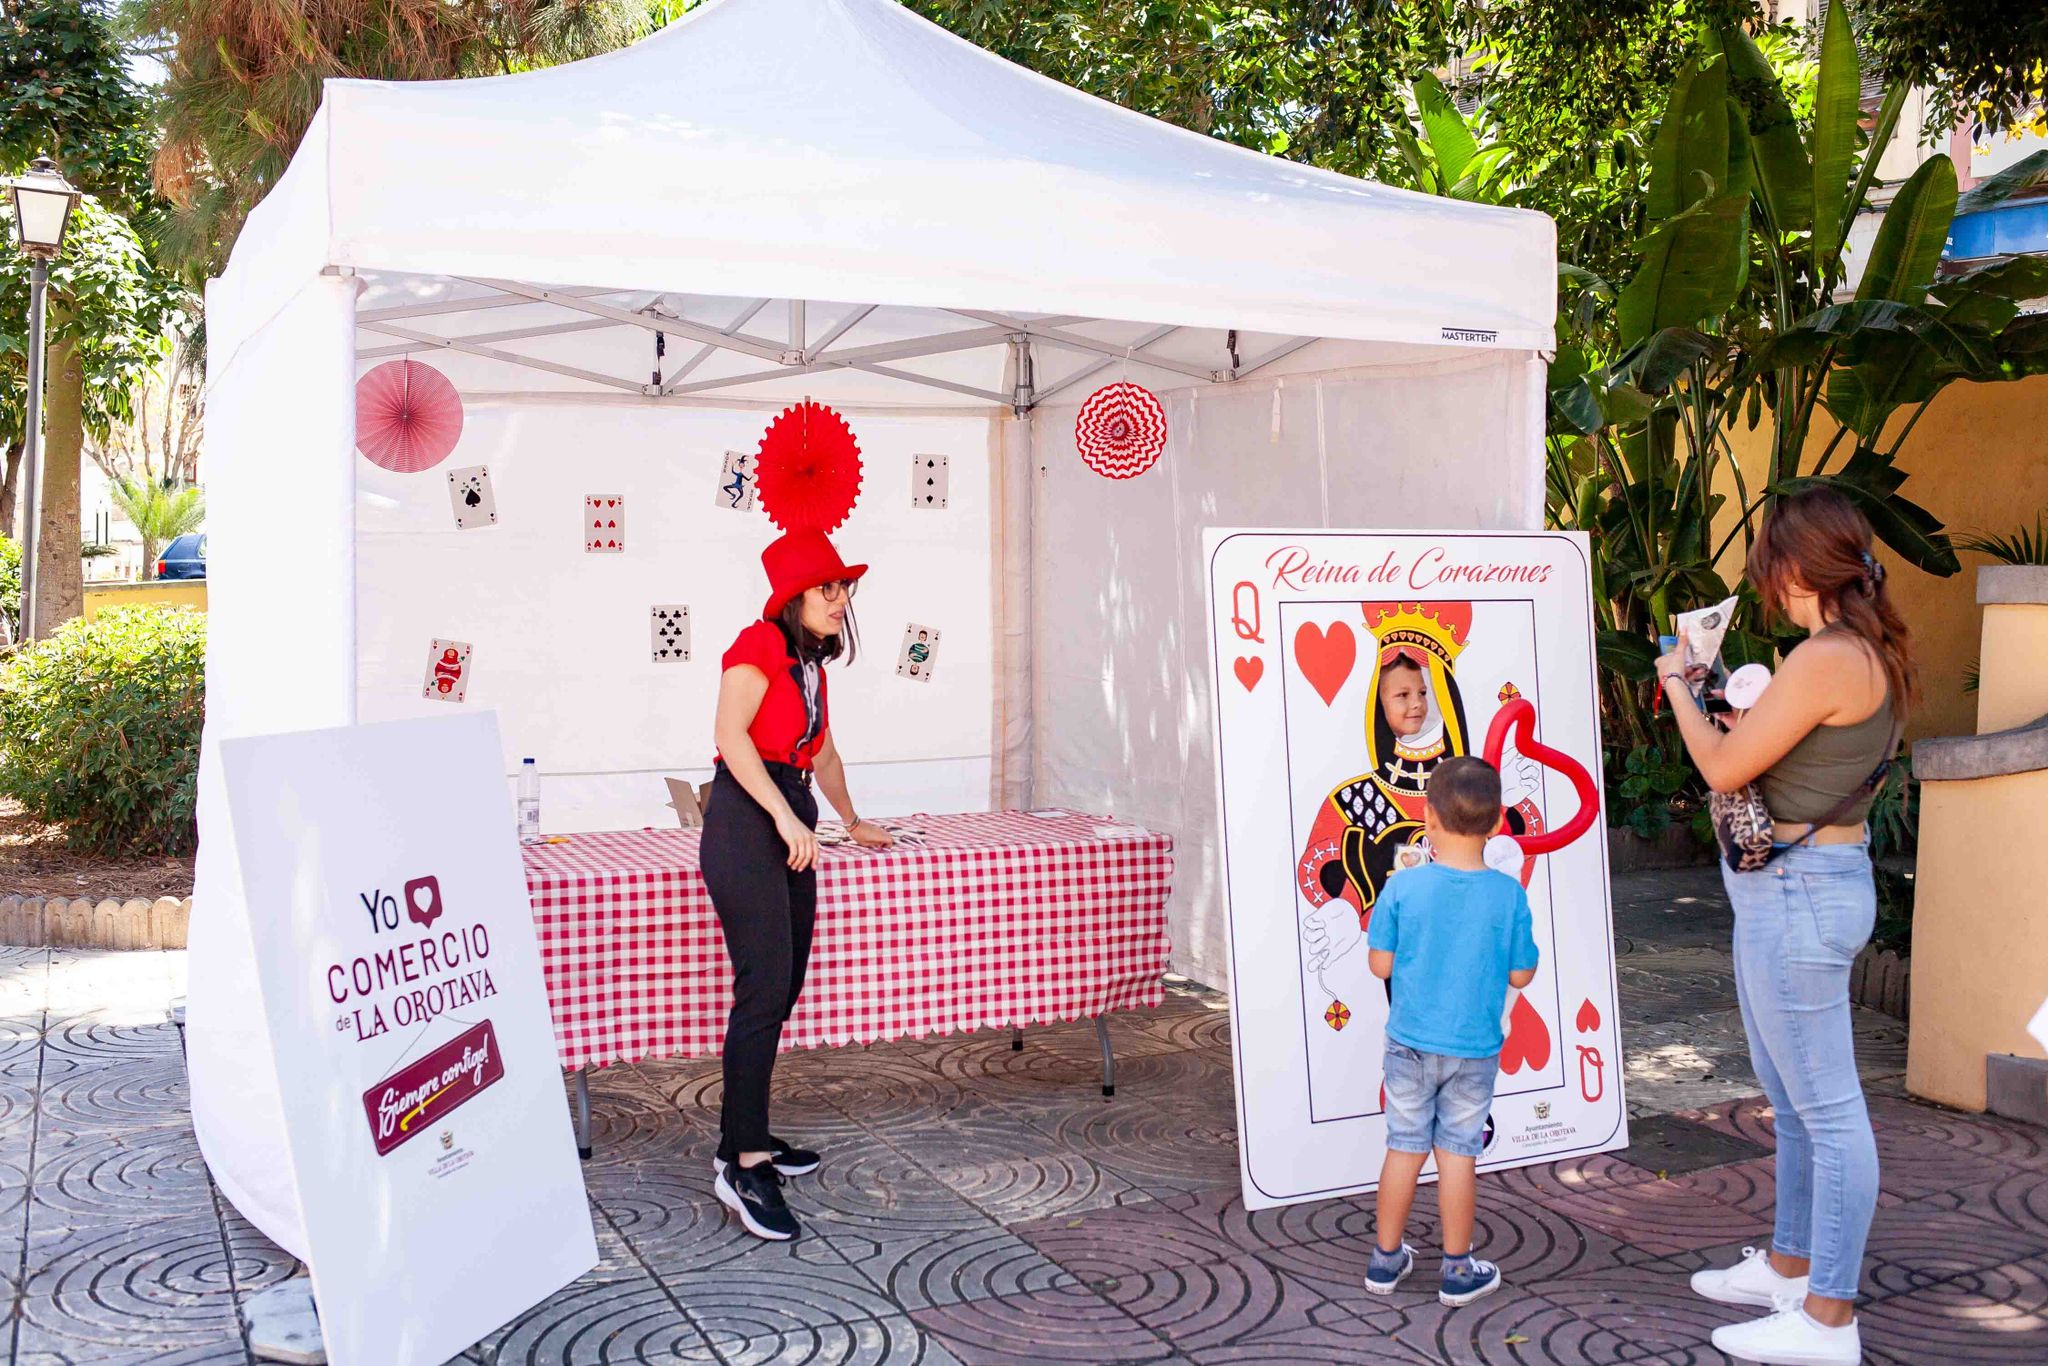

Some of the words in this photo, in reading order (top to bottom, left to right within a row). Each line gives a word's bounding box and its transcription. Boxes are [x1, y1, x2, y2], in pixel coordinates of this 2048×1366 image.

[1441, 331, 1498, 343] MASTERTENT
[1265, 545, 1361, 592] Reina
[1367, 550, 1401, 583] de
[1408, 546, 1553, 590] Corazones
[1231, 581, 1264, 644] Q
[327, 923, 490, 1004] COMERCIO
[335, 1014, 352, 1031] de
[352, 1003, 390, 1042] LA
[394, 968, 498, 1026] OROTAVA
[441, 1033, 489, 1086] contigo!
[1575, 1045, 1605, 1103] Q
[1511, 1134, 1530, 1143] VILLA
